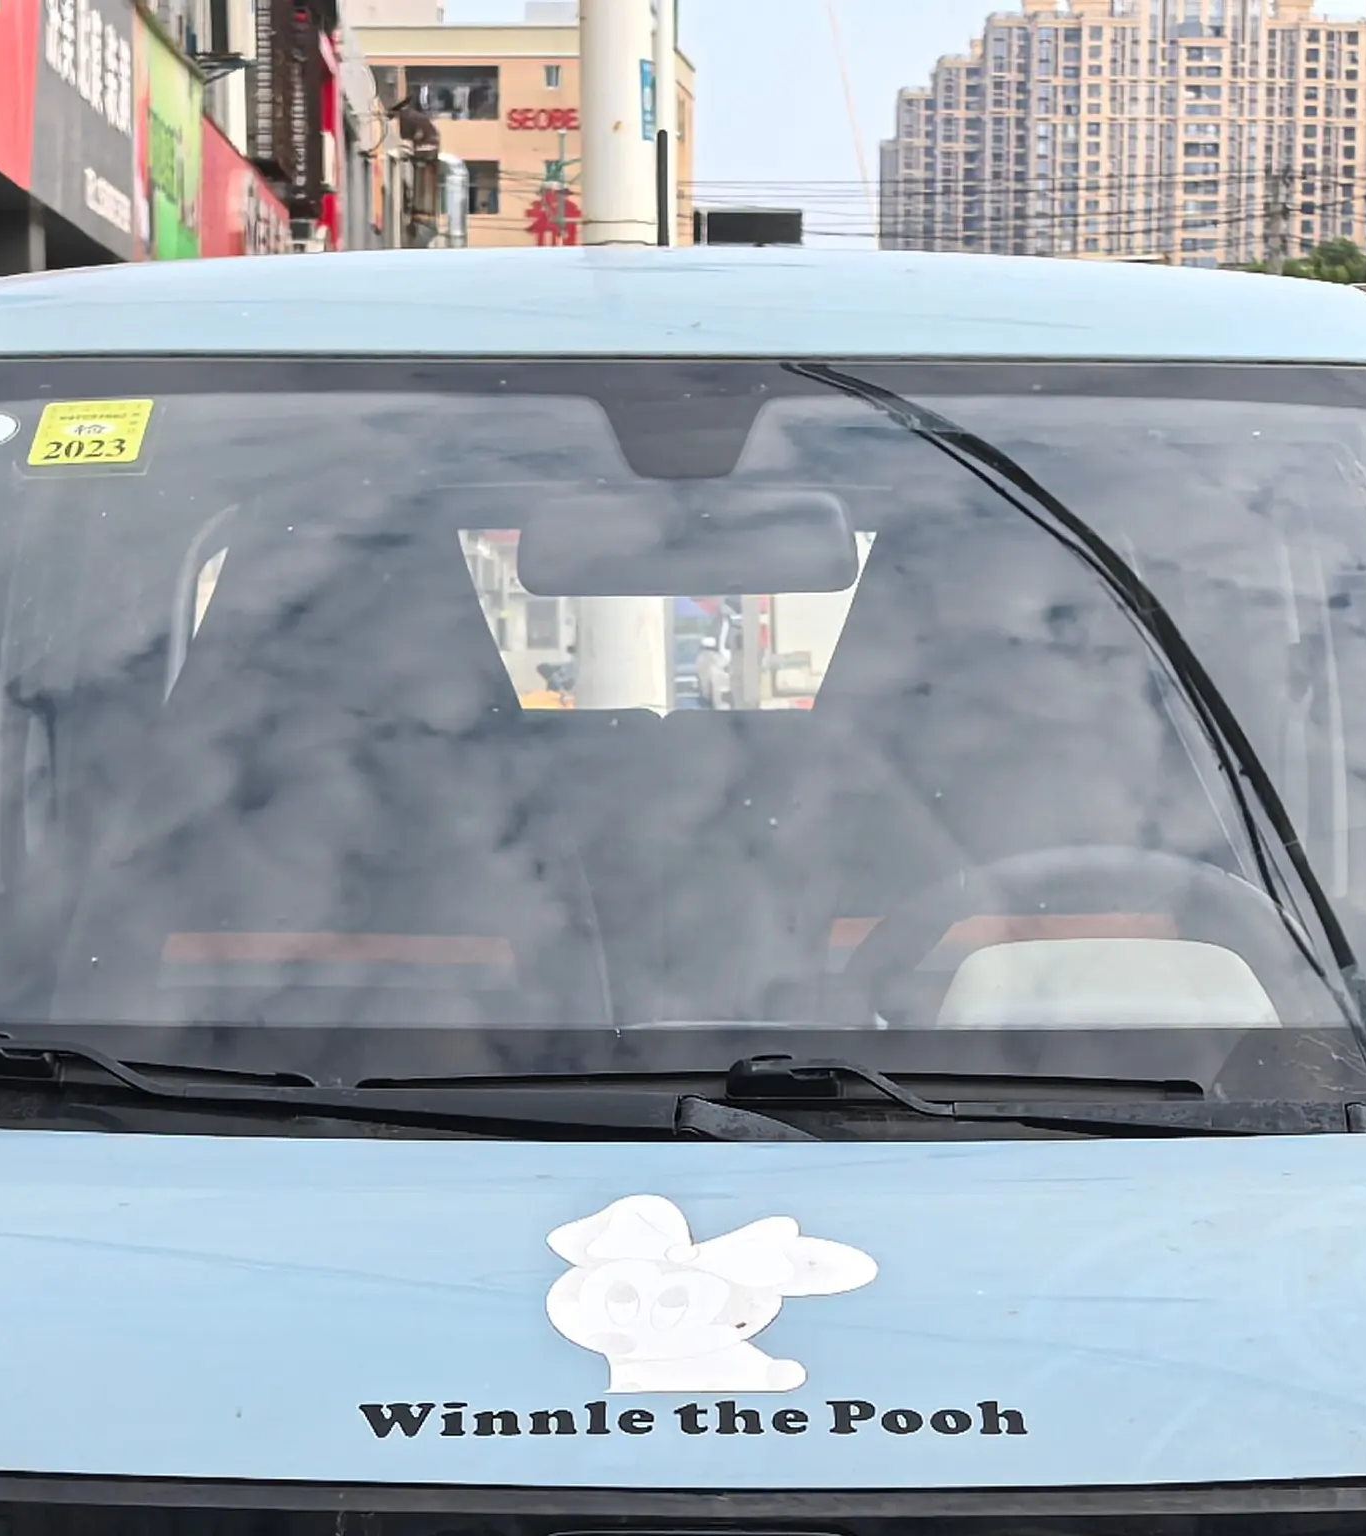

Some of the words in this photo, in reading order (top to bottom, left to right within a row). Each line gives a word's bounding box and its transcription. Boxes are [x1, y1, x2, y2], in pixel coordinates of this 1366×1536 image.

[42, 438, 127, 460] 2023
[359, 1401, 654, 1438] Winnle
[674, 1401, 809, 1436] the
[827, 1400, 1029, 1436] Pooh
